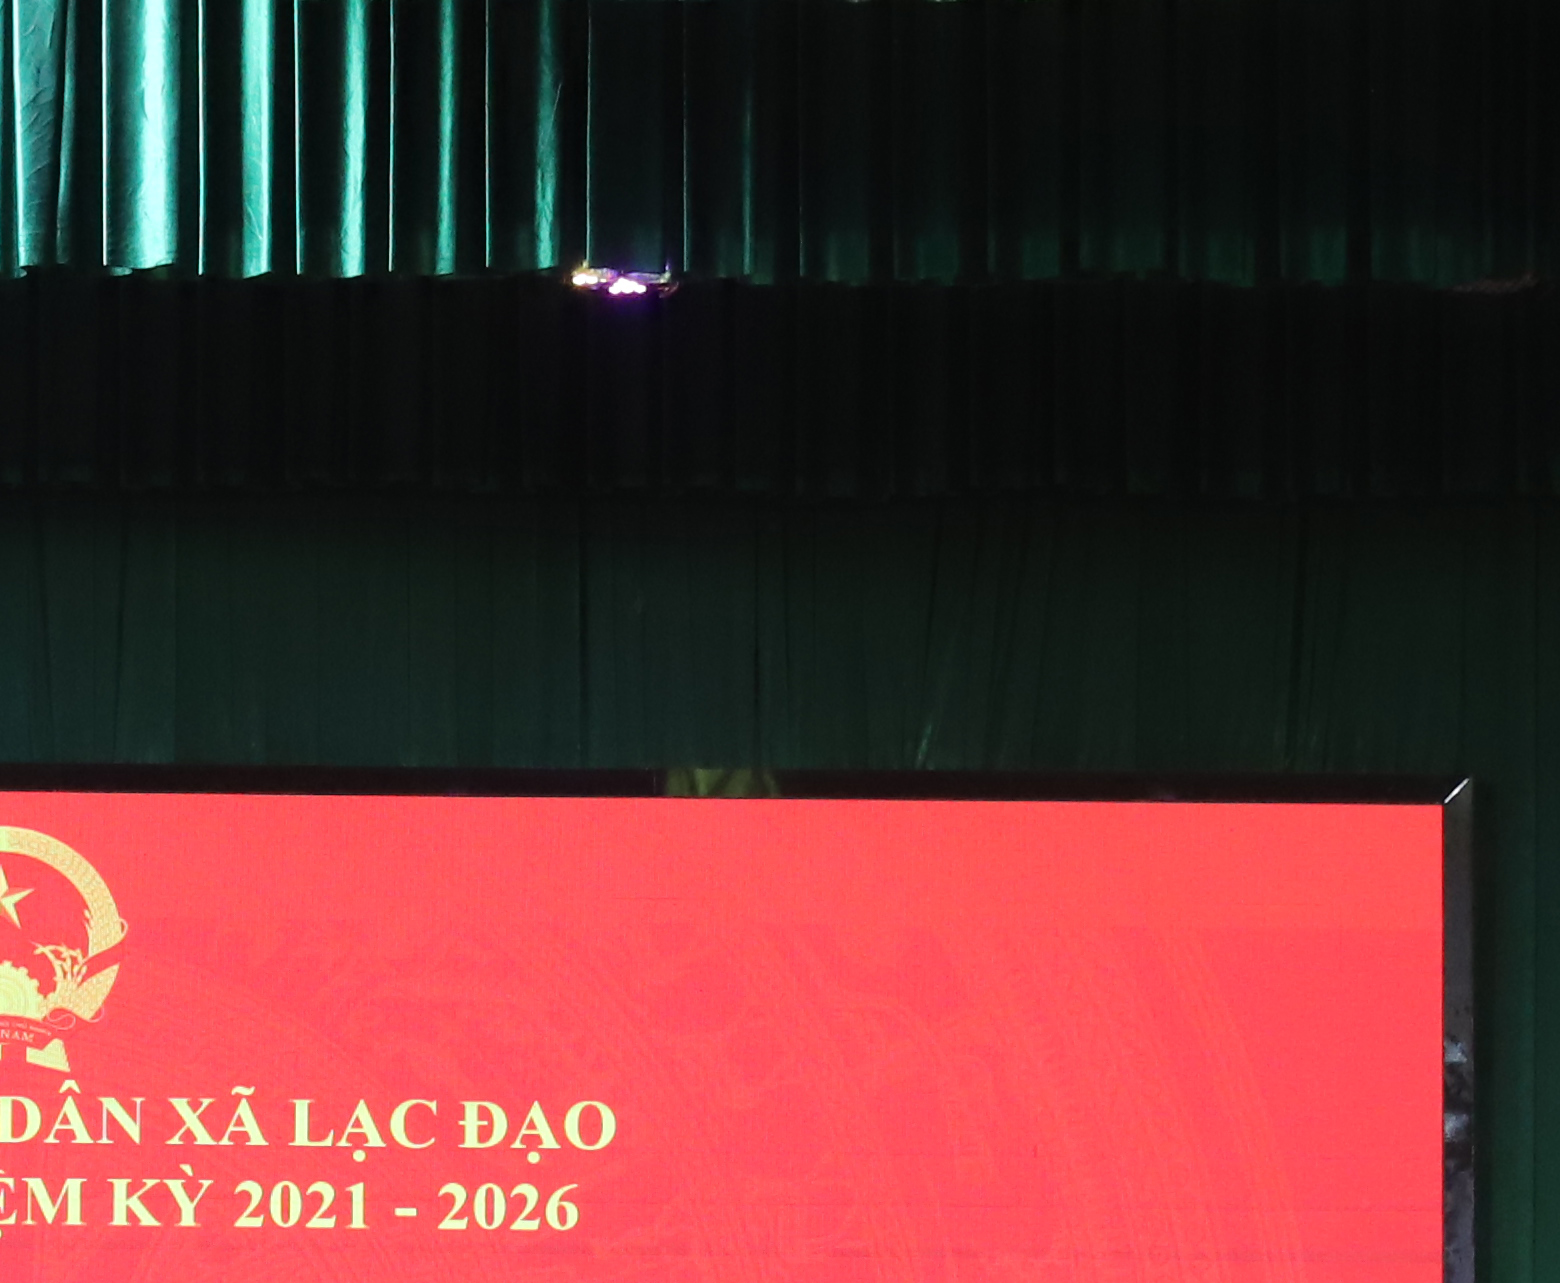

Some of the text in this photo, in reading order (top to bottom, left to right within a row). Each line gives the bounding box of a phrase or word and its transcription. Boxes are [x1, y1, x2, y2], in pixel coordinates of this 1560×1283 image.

[166, 1085, 269, 1146] XÃ
[288, 1099, 437, 1163] LẠC
[458, 1100, 617, 1164] ĐẠO
[106, 1162, 214, 1227] KỲ
[233, 1180, 367, 1229] 2021
[394, 1207, 418, 1217] -
[437, 1182, 579, 1231] 2026
